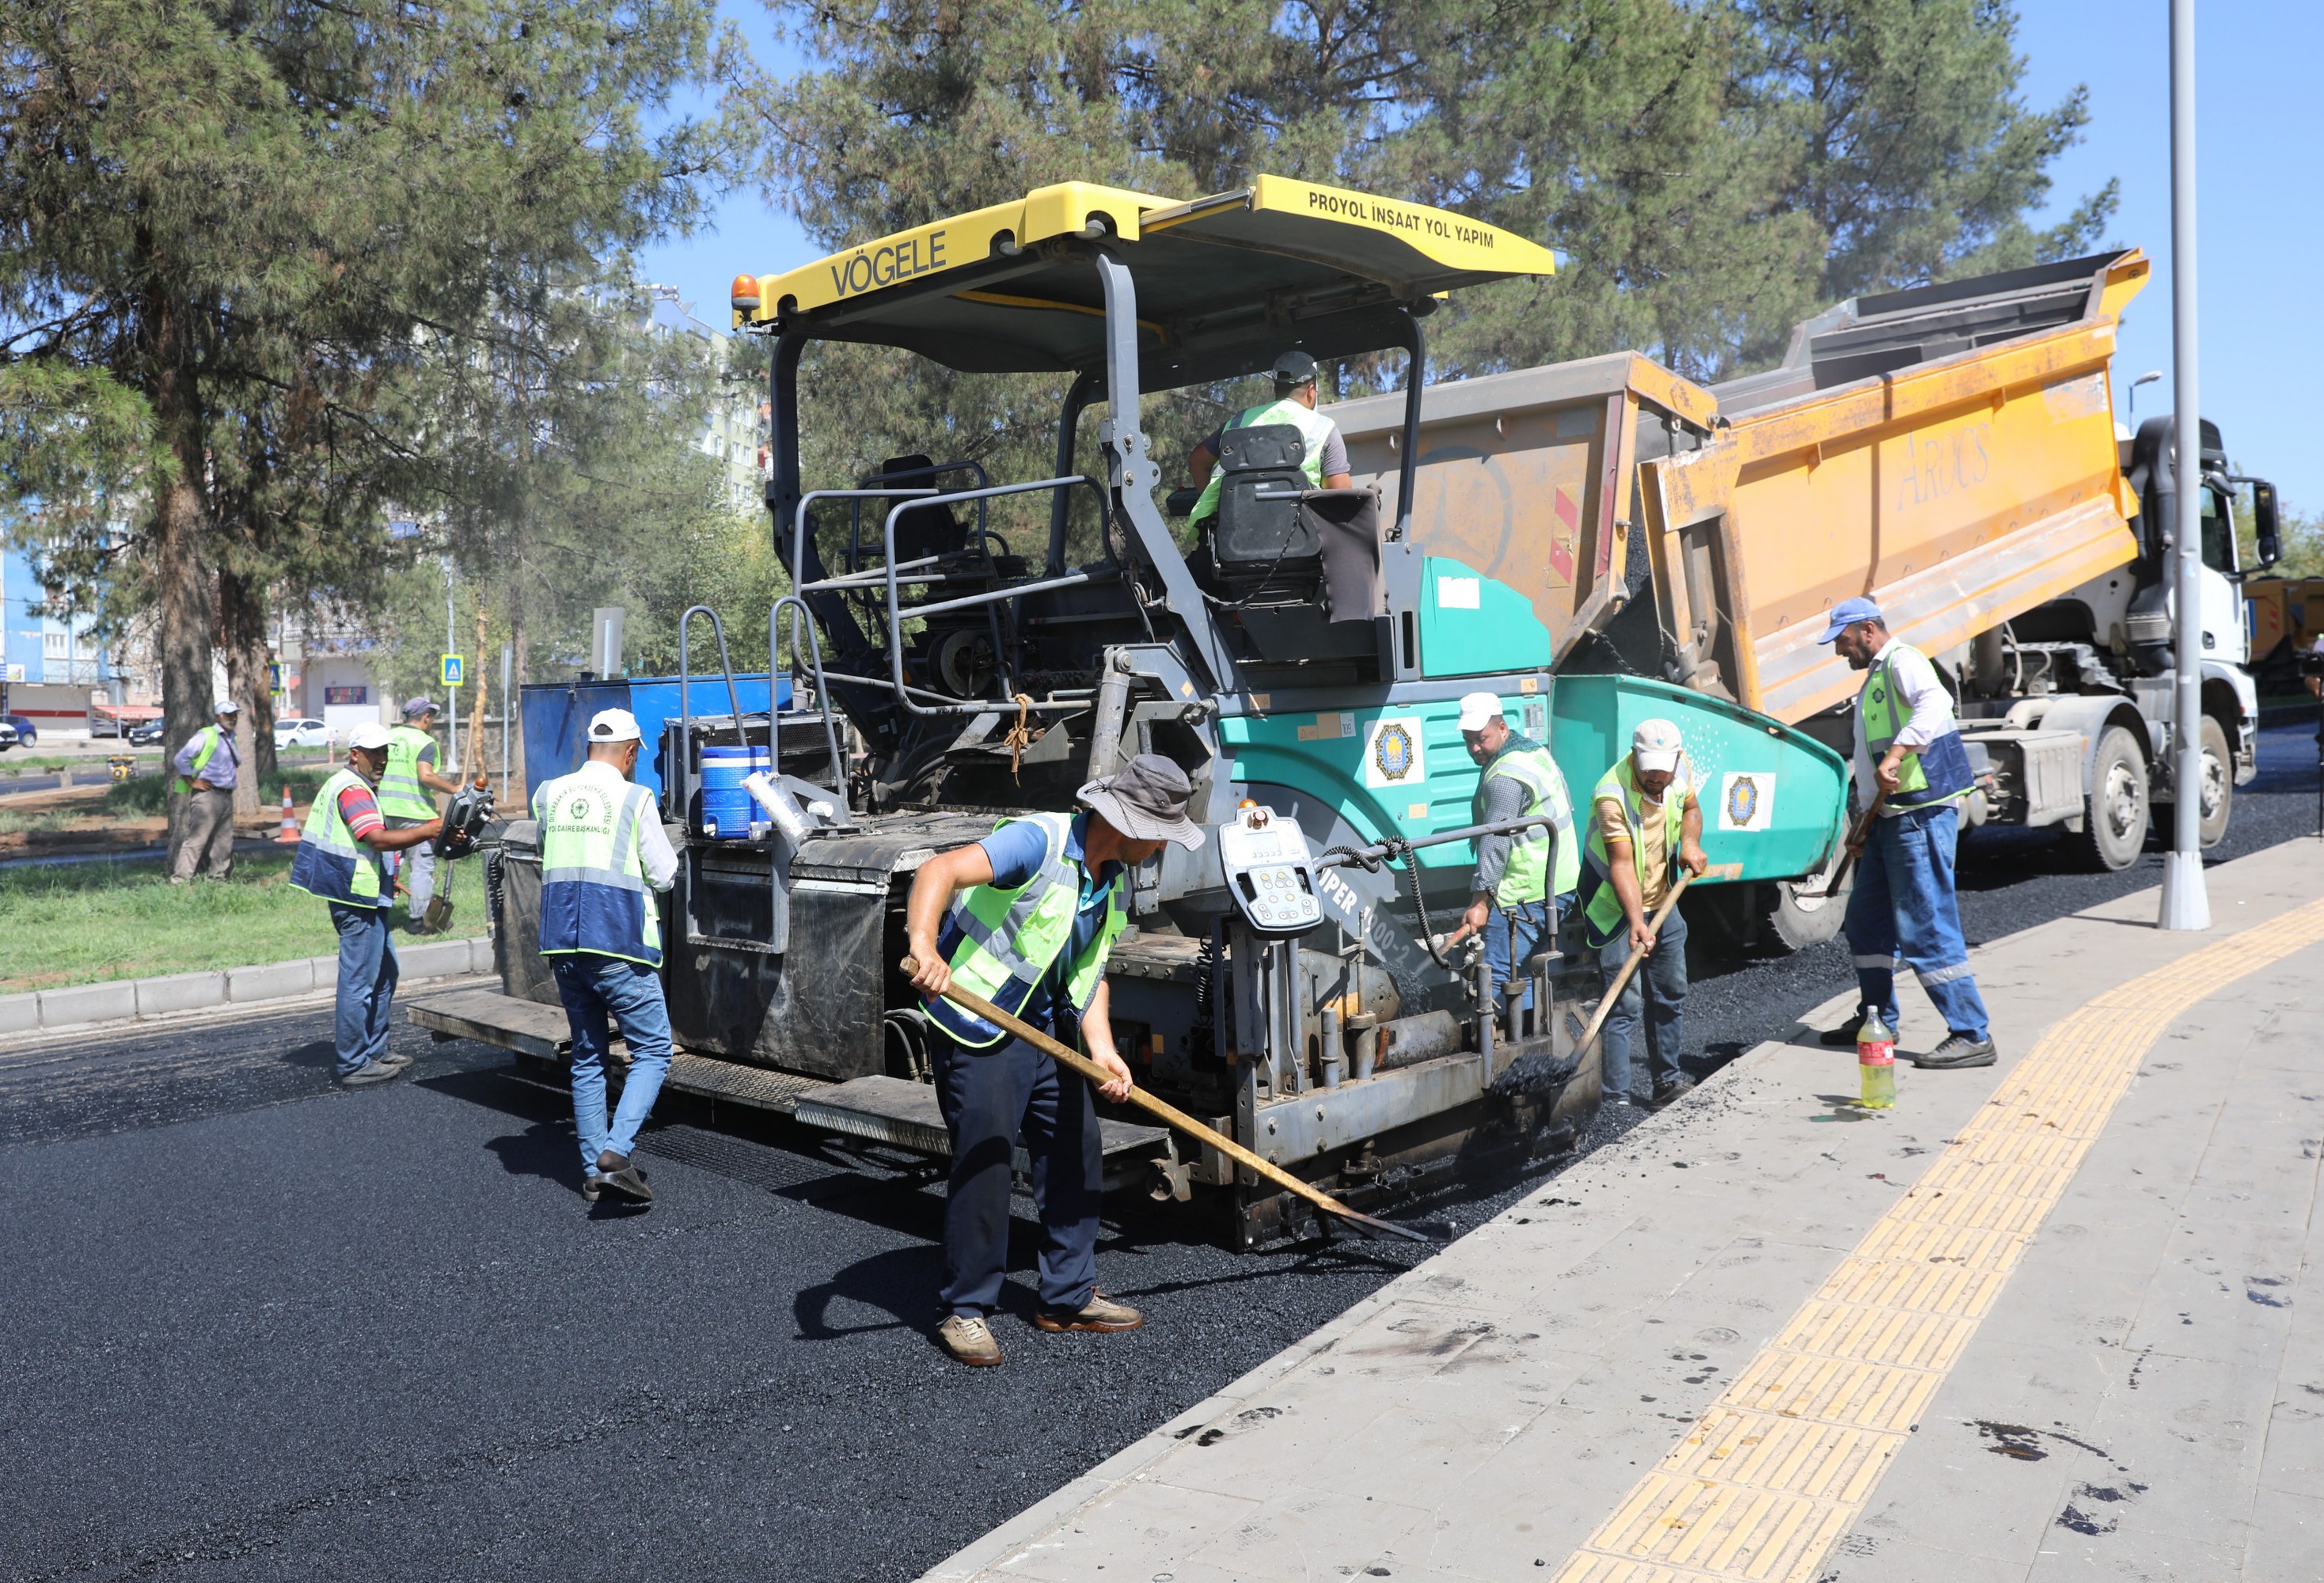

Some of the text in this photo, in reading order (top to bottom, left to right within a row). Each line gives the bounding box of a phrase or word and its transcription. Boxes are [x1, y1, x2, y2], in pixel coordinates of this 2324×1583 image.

[1309, 192, 1493, 249] PROYOL İNŞAAT YOL YAPIM
[831, 230, 947, 297] VÖGELE
[1897, 423, 1988, 511] AROCS
